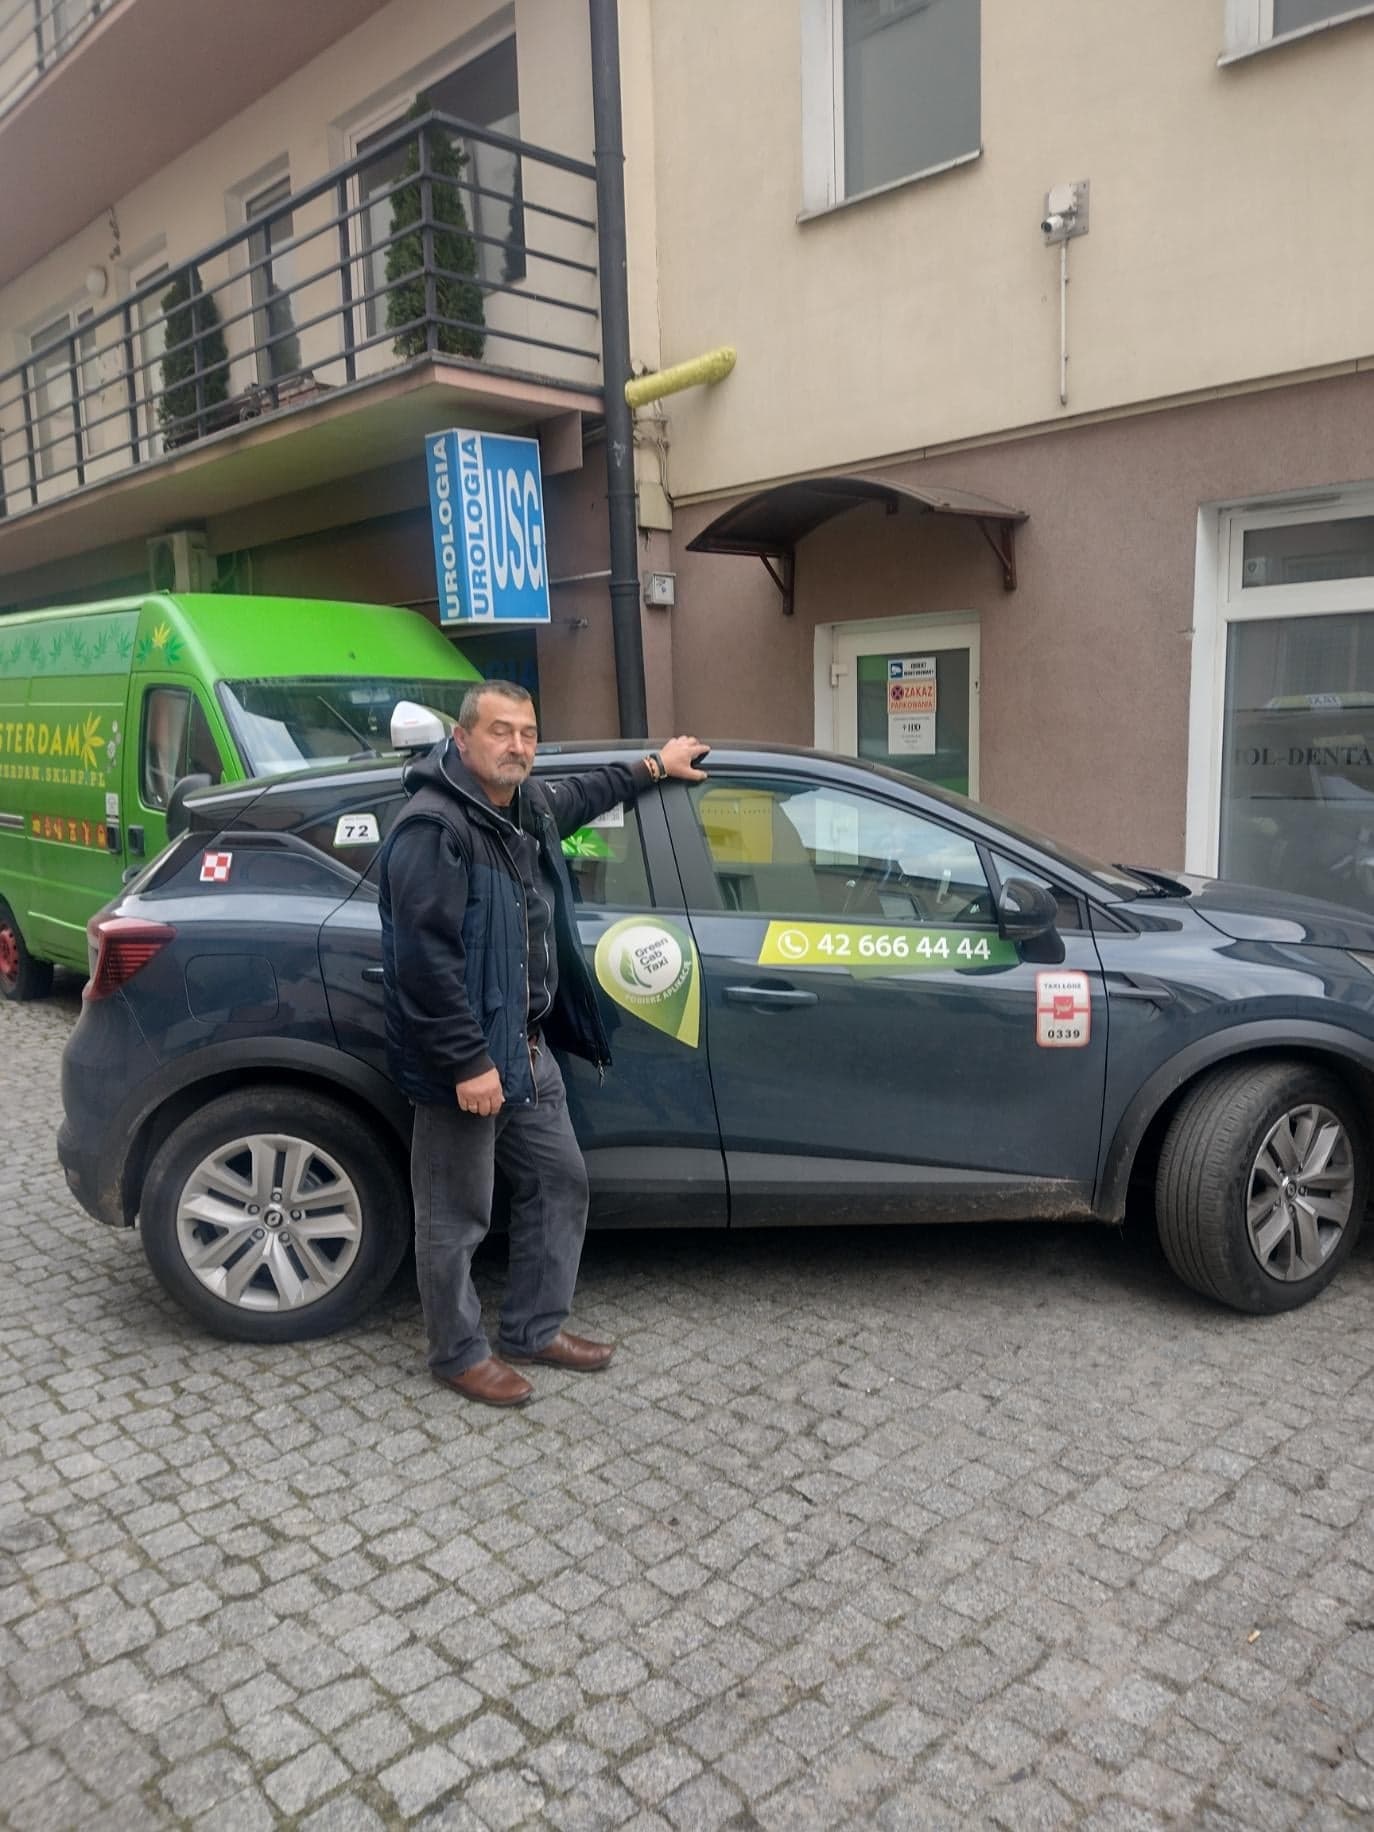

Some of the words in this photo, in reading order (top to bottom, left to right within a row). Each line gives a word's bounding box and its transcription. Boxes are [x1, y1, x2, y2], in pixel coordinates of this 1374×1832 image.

[433, 437, 460, 618] UROLOGIA
[462, 436, 490, 615] UROLOGIA
[486, 468, 544, 590] USG
[904, 686, 933, 698] ZAKAZ
[1235, 747, 1374, 766] OL-DENTA
[344, 825, 369, 838] 72
[634, 938, 669, 957] Green
[817, 933, 850, 956] 42
[858, 935, 909, 957] 666
[916, 936, 948, 958] 44
[956, 937, 991, 960] 44
[640, 950, 663, 966] Cab
[644, 957, 669, 974] Taxi
[1047, 1029, 1081, 1039] 0339
